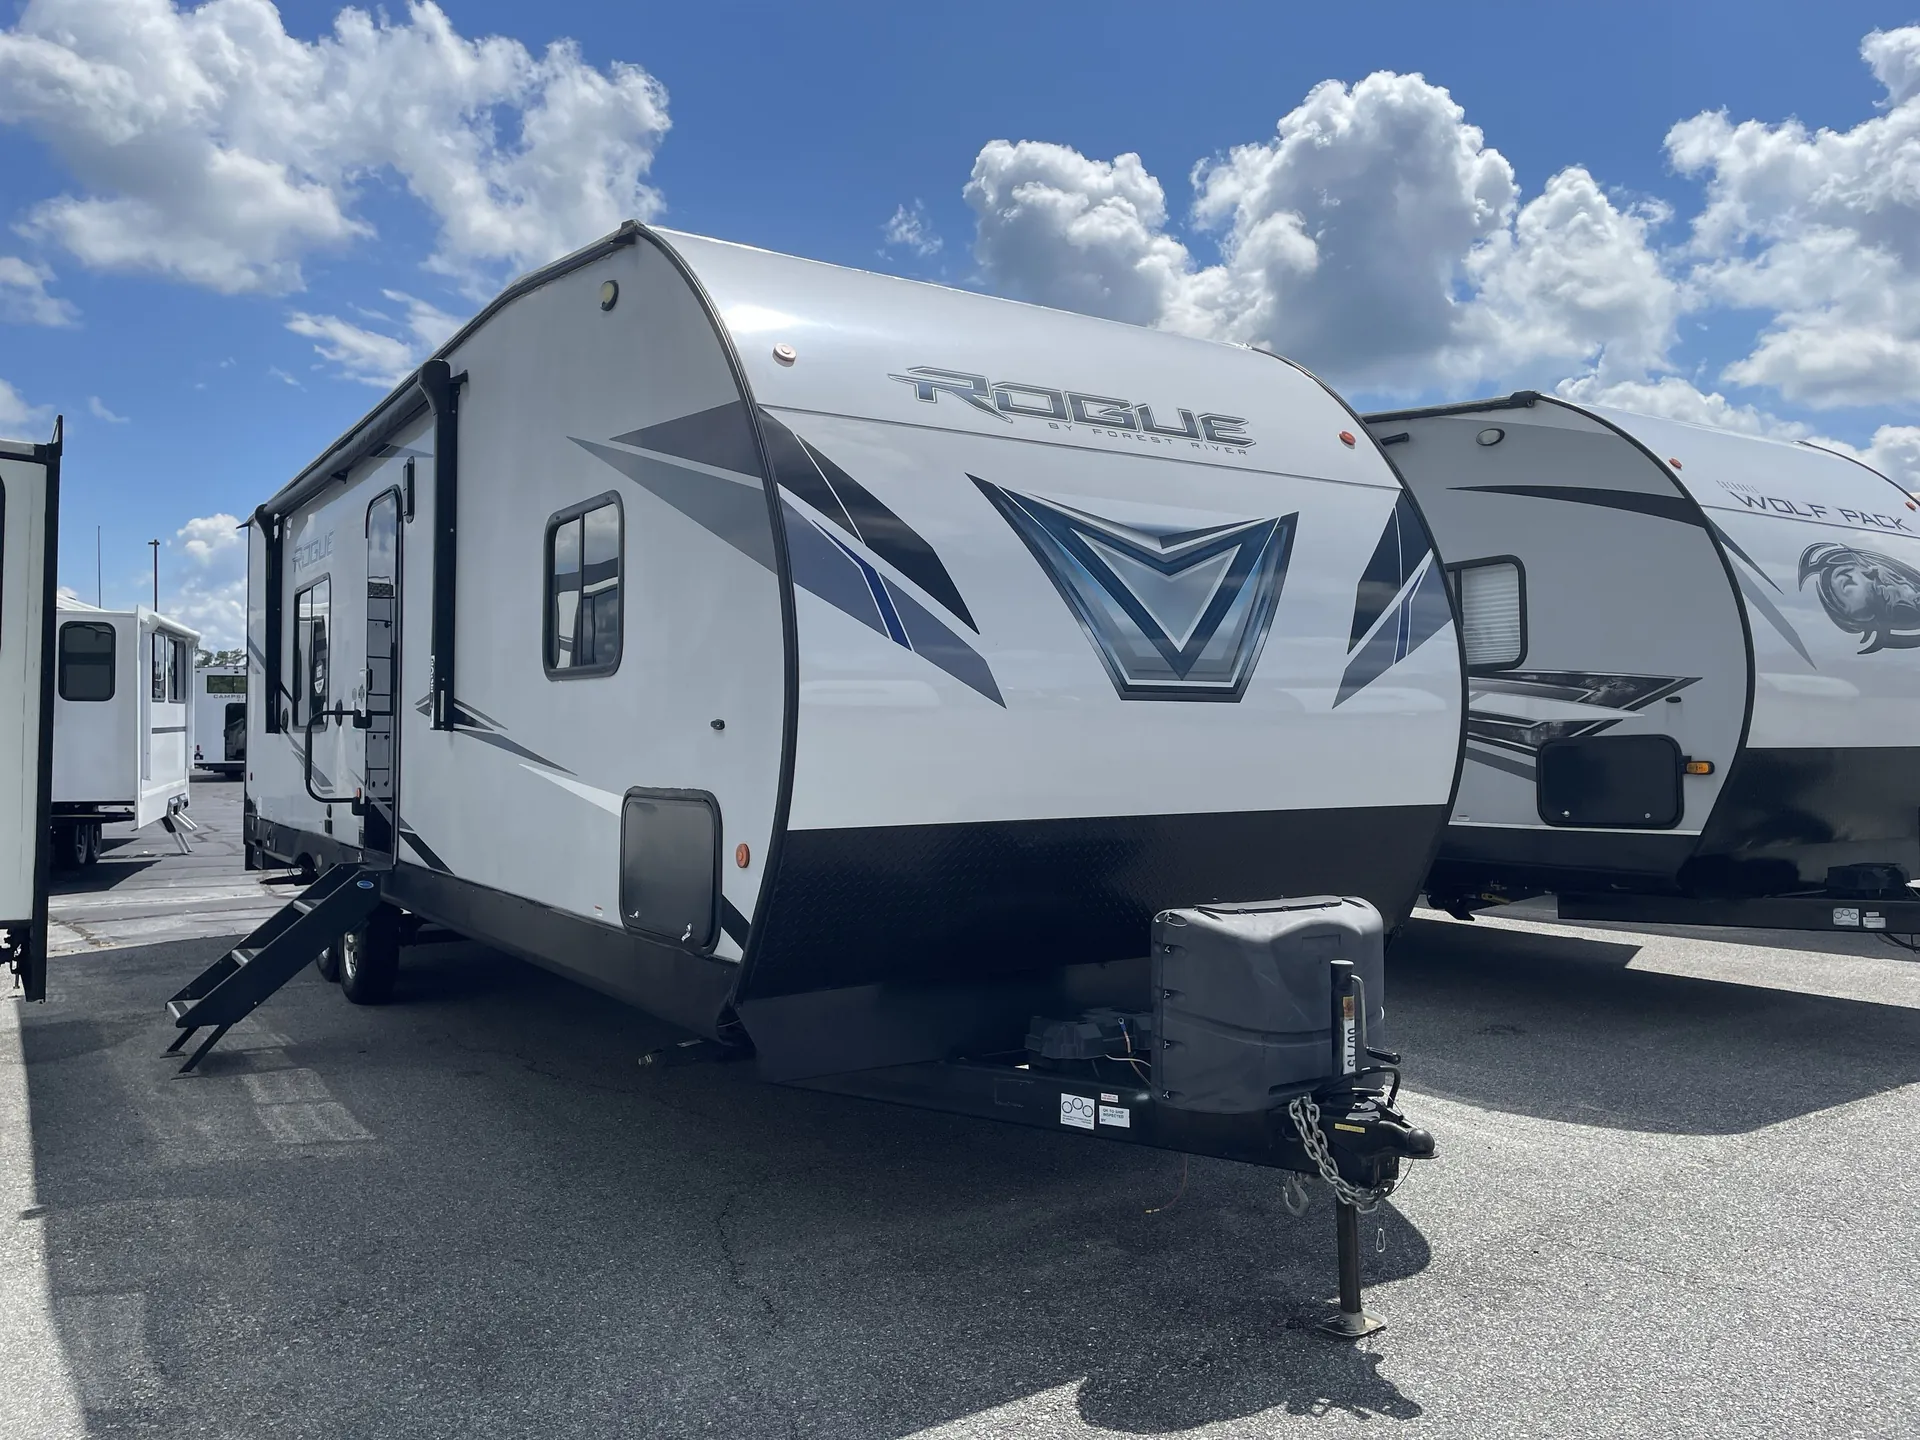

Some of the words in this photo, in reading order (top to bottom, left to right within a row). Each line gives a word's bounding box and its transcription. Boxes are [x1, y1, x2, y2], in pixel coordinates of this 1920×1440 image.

[887, 365, 1256, 448] ROGUE
[1048, 422, 1073, 432] BY
[1092, 427, 1174, 446] FOREST
[1191, 442, 1248, 456] RIVER
[1728, 491, 1827, 518] WOLF
[1837, 508, 1914, 533] PACK
[292, 530, 334, 572] ROGUE
